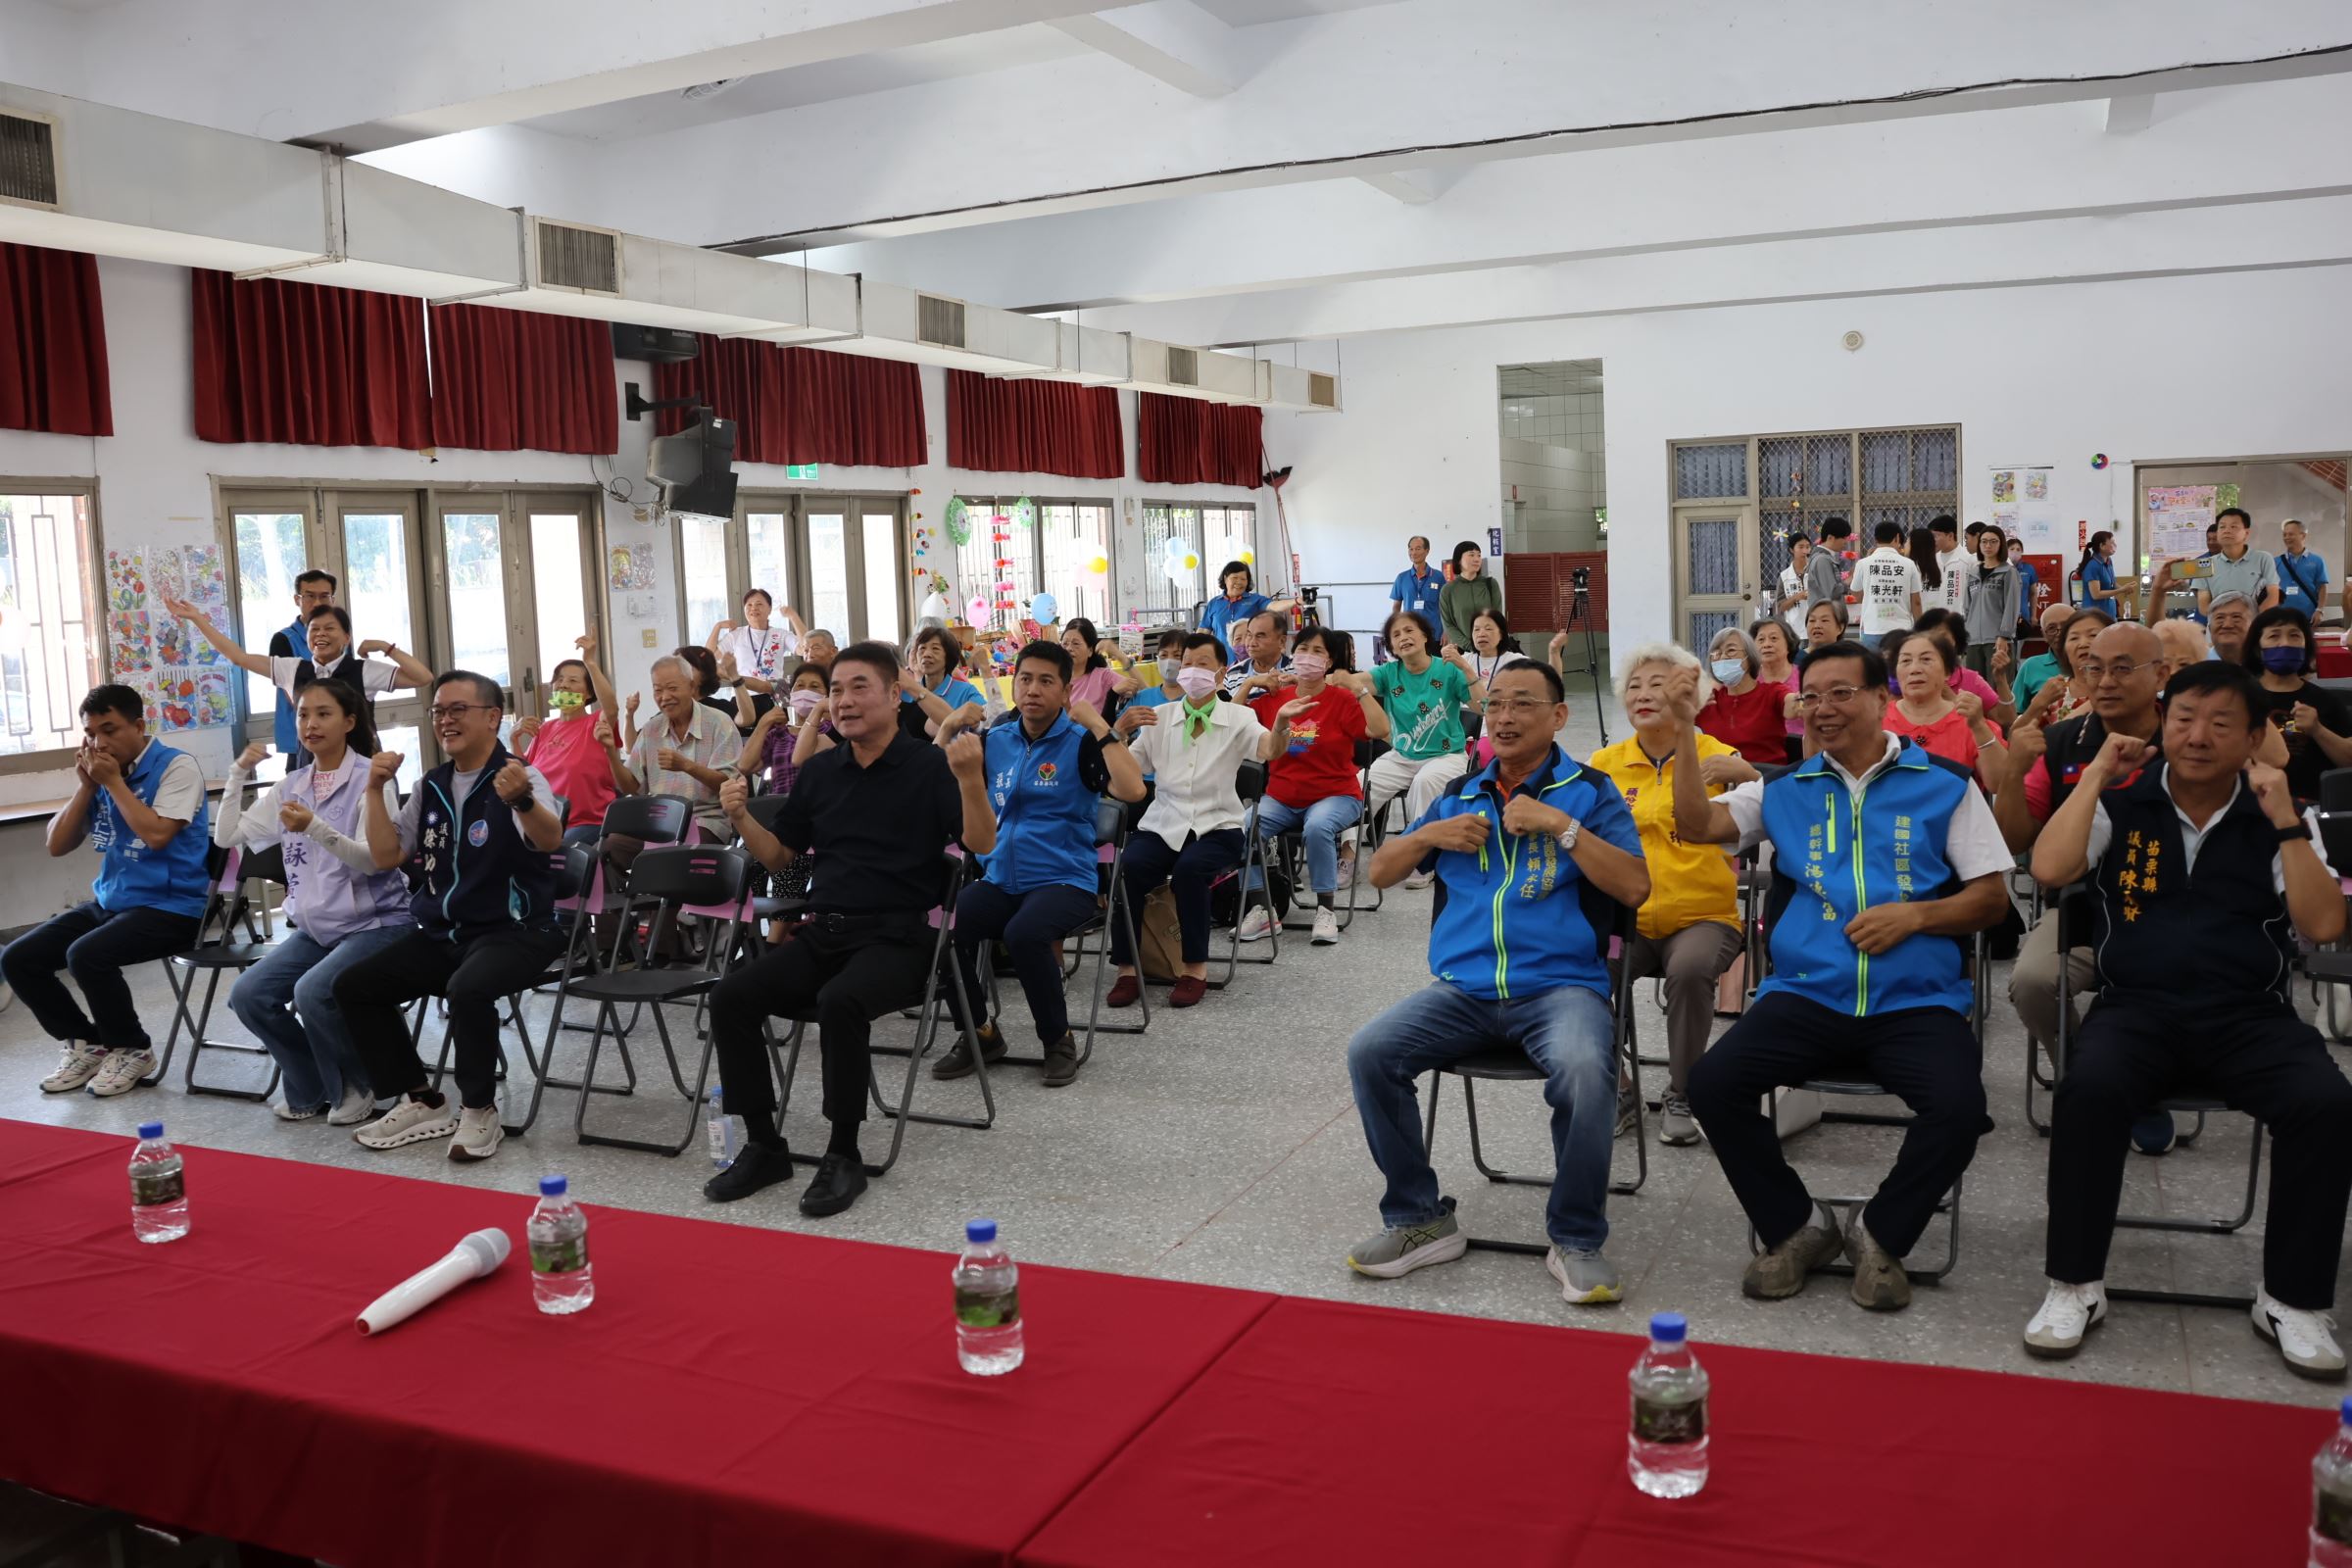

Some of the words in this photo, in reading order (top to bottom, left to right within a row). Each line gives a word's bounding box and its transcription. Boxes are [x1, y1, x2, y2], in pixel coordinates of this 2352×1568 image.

[1869, 564, 1904, 576] 陳品安
[1871, 585, 1903, 597] 陳光軒
[1894, 815, 1914, 902] 建國社區發
[2143, 840, 2160, 892] 苗栗縣
